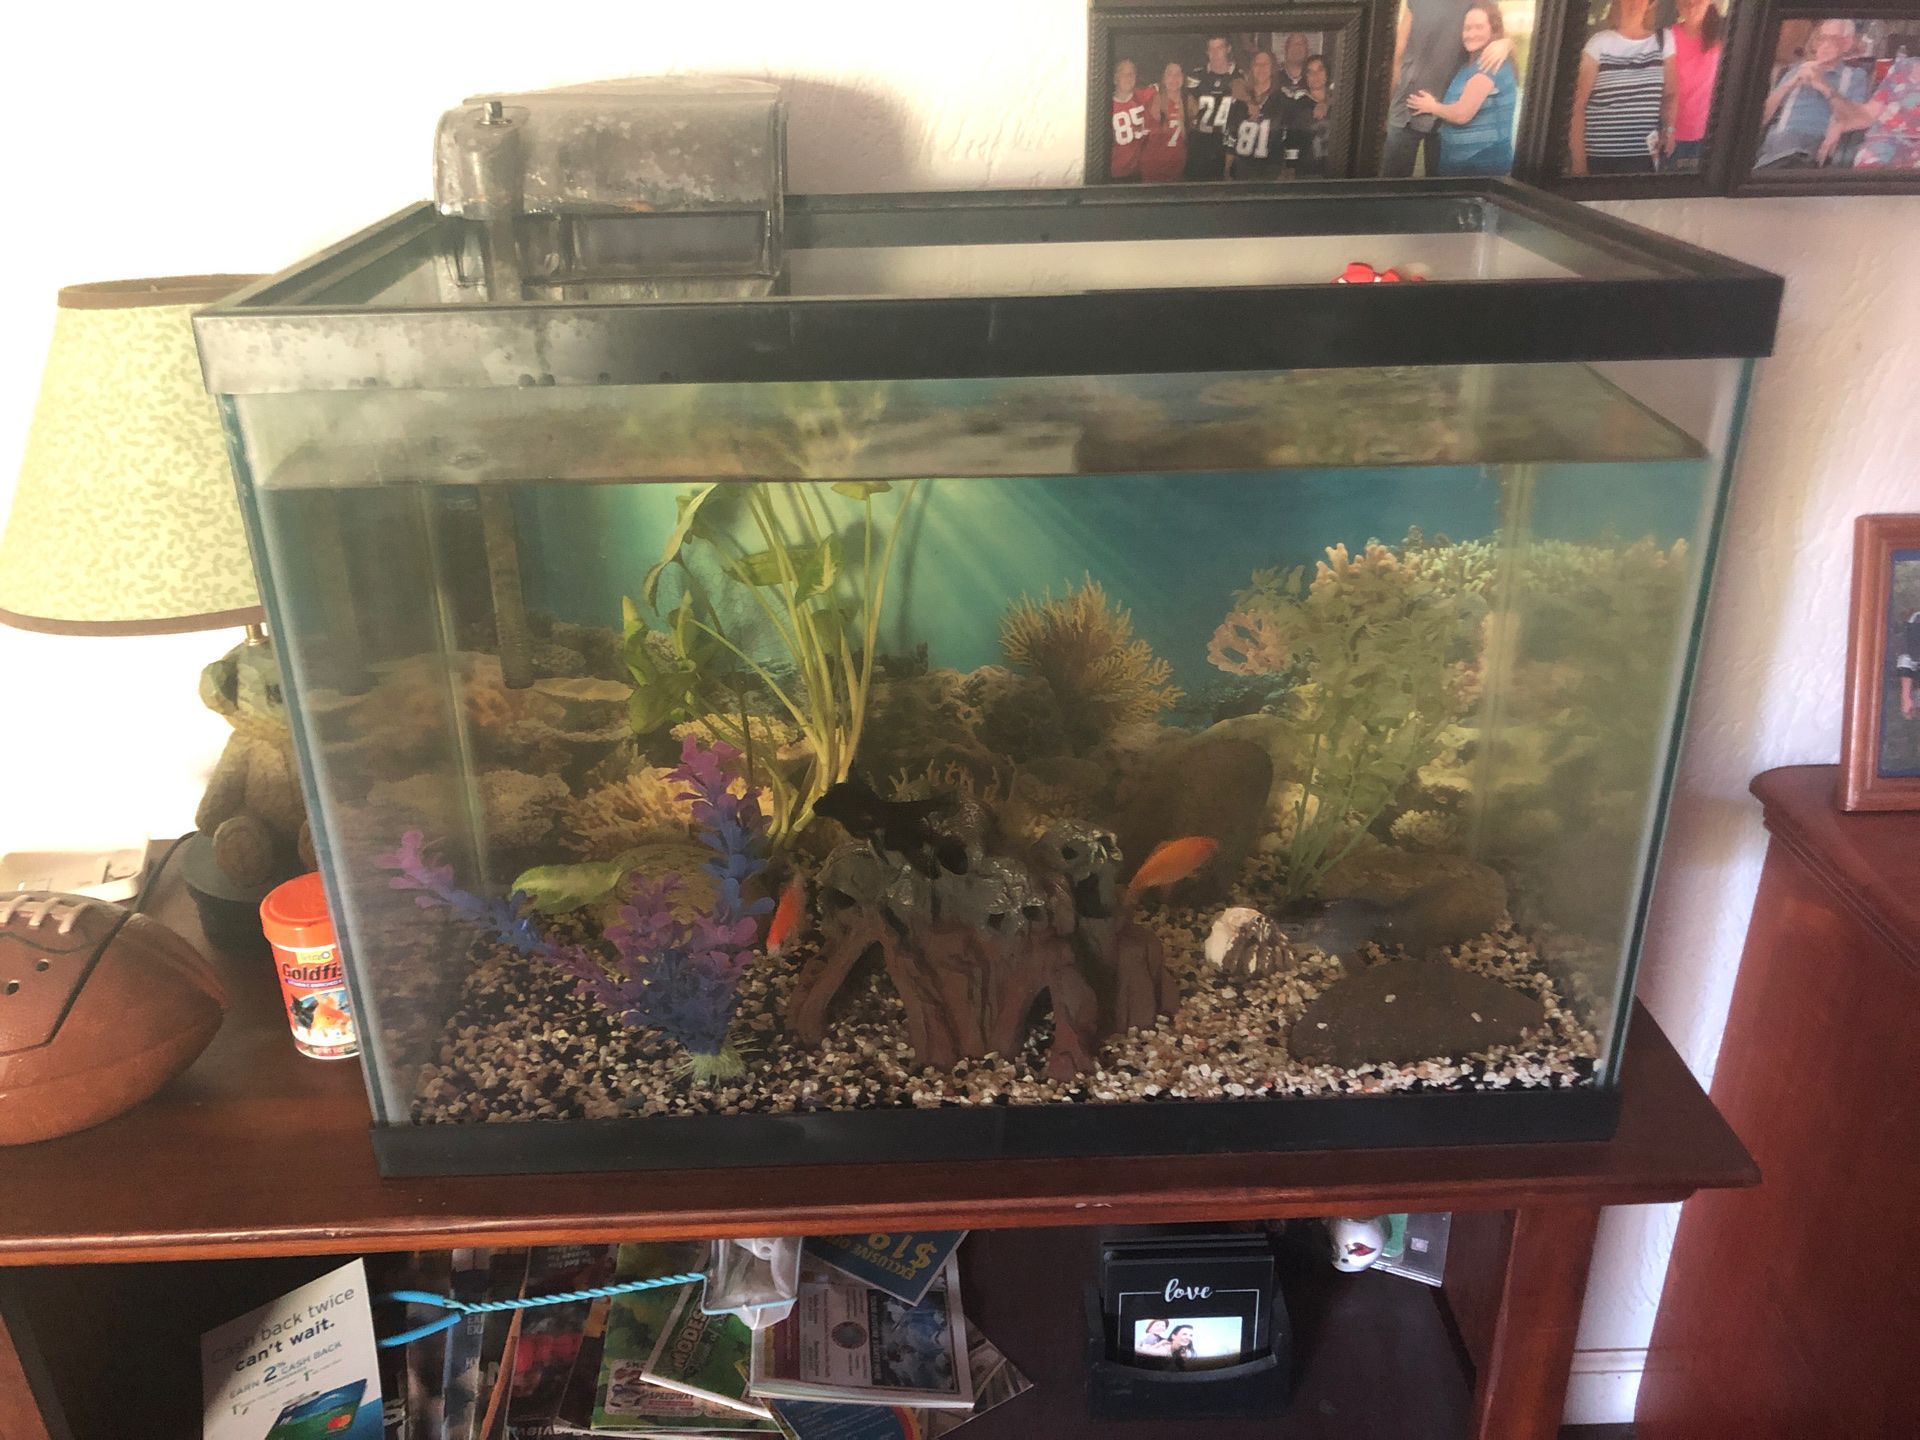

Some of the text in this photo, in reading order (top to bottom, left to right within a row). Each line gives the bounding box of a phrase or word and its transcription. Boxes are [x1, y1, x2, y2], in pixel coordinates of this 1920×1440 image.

[1112, 105, 1149, 146] 85
[1199, 95, 1233, 133] 24
[1235, 119, 1271, 159] 81
[1164, 1277, 1213, 1303] love
[261, 1313, 303, 1341] back
[307, 1288, 355, 1318] twice
[235, 1341, 283, 1372] can't
[290, 1318, 336, 1346] wait.
[281, 1356, 311, 1375] CASH
[313, 1341, 343, 1360] BACK
